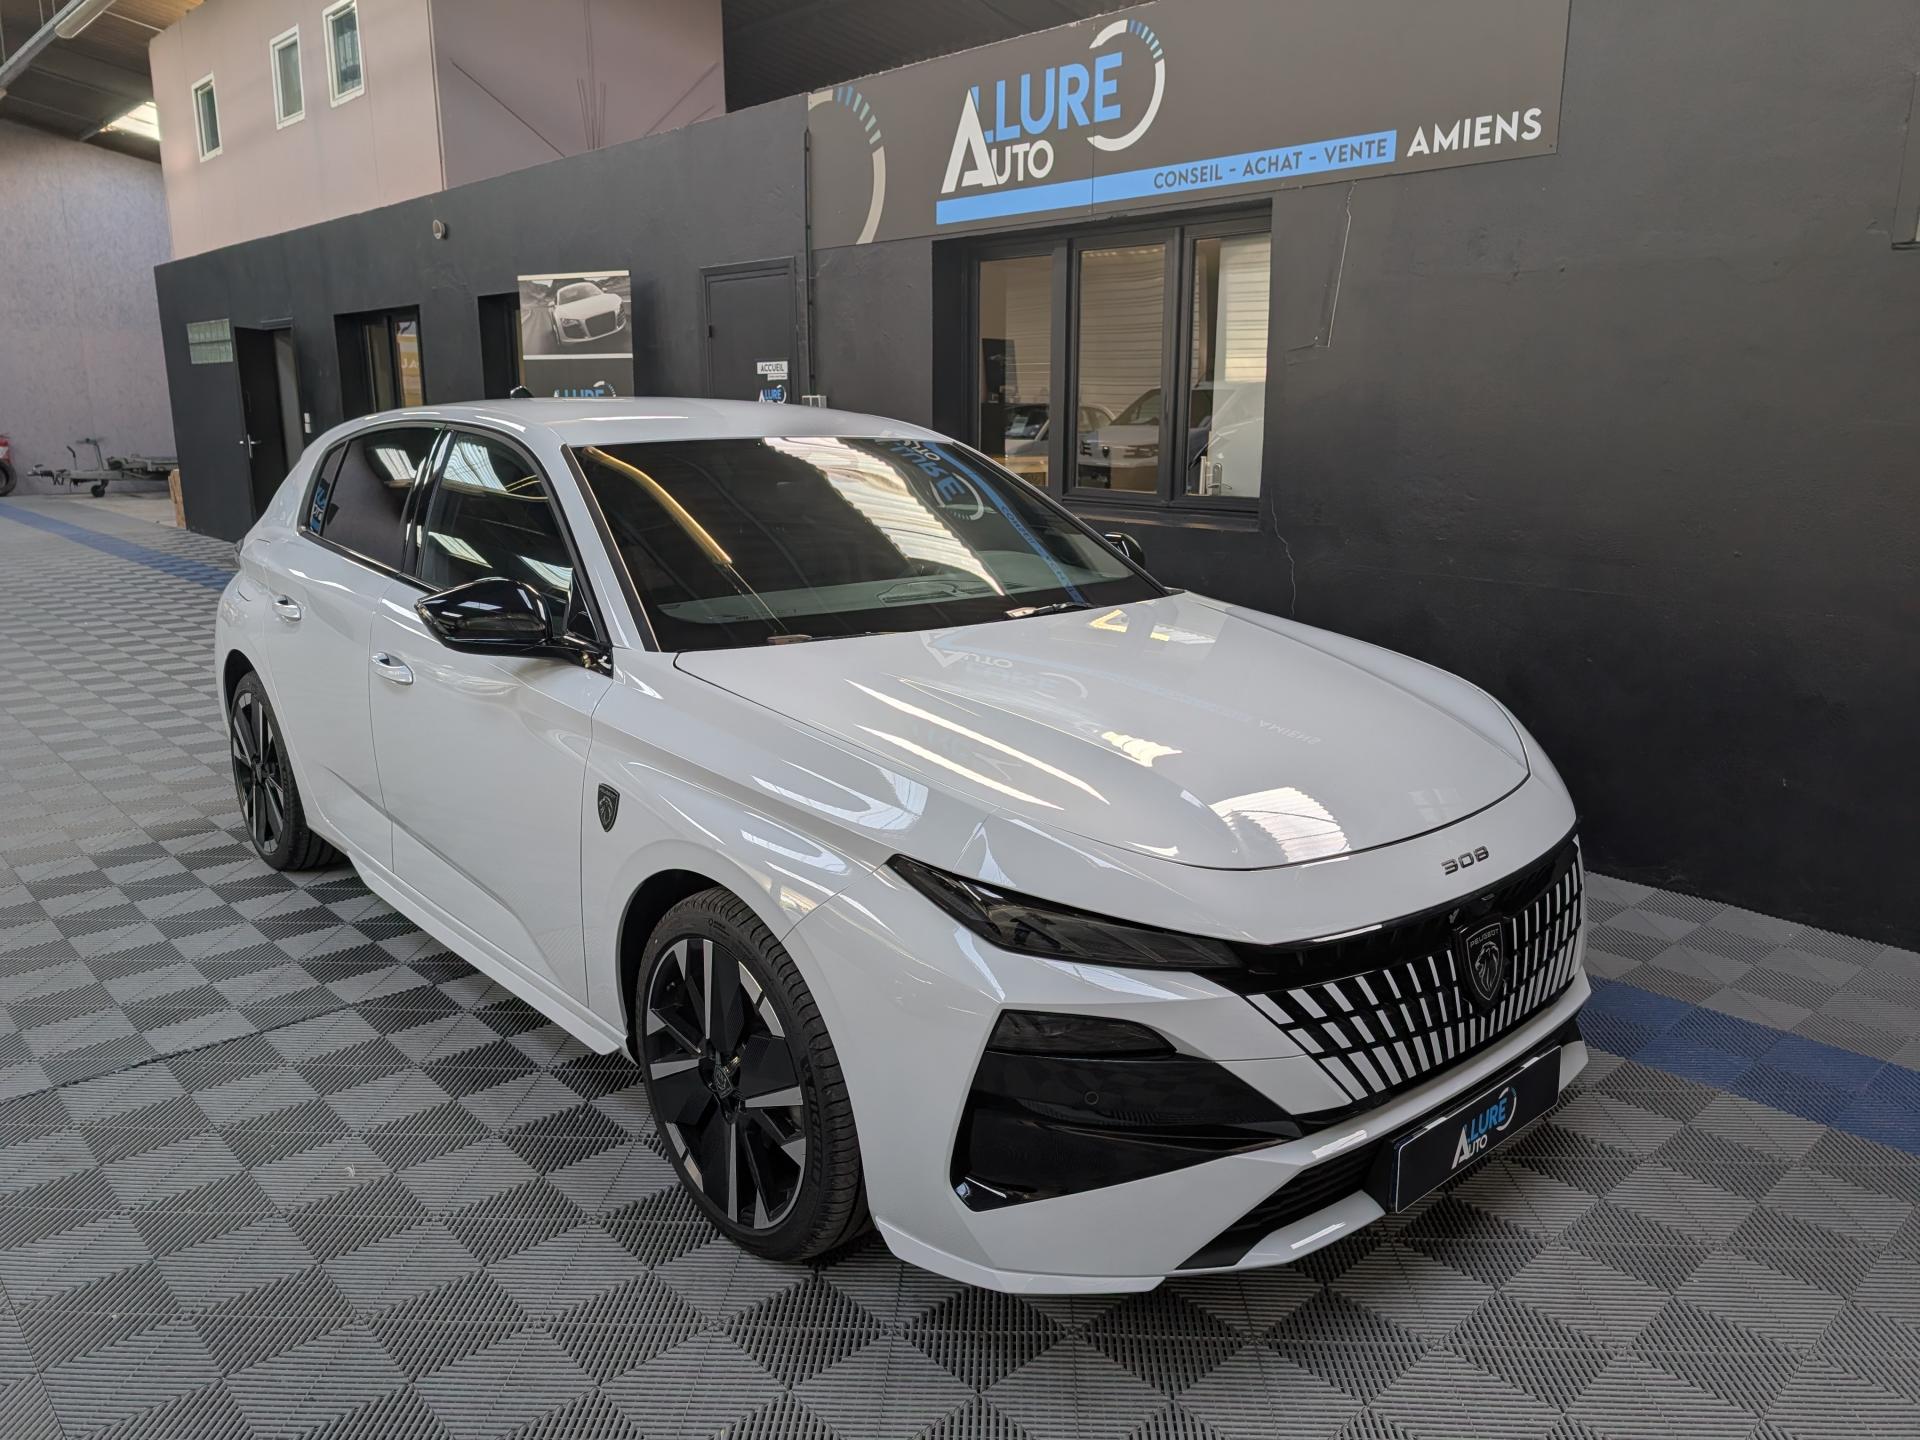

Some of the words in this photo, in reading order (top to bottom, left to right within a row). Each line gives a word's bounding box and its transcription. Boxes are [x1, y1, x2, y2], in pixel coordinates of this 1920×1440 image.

[941, 89, 1054, 194] AUTO
[1406, 107, 1542, 157] AMIENS
[1153, 164, 1223, 190] CONSEIL
[1243, 151, 1303, 177] ACHAT
[1324, 138, 1388, 164] VENTE
[761, 363, 785, 372] ACCUEIL
[1441, 846, 1489, 875] 308
[1469, 928, 1499, 947] PEUGEOT
[1451, 1126, 1487, 1170] AUTO
